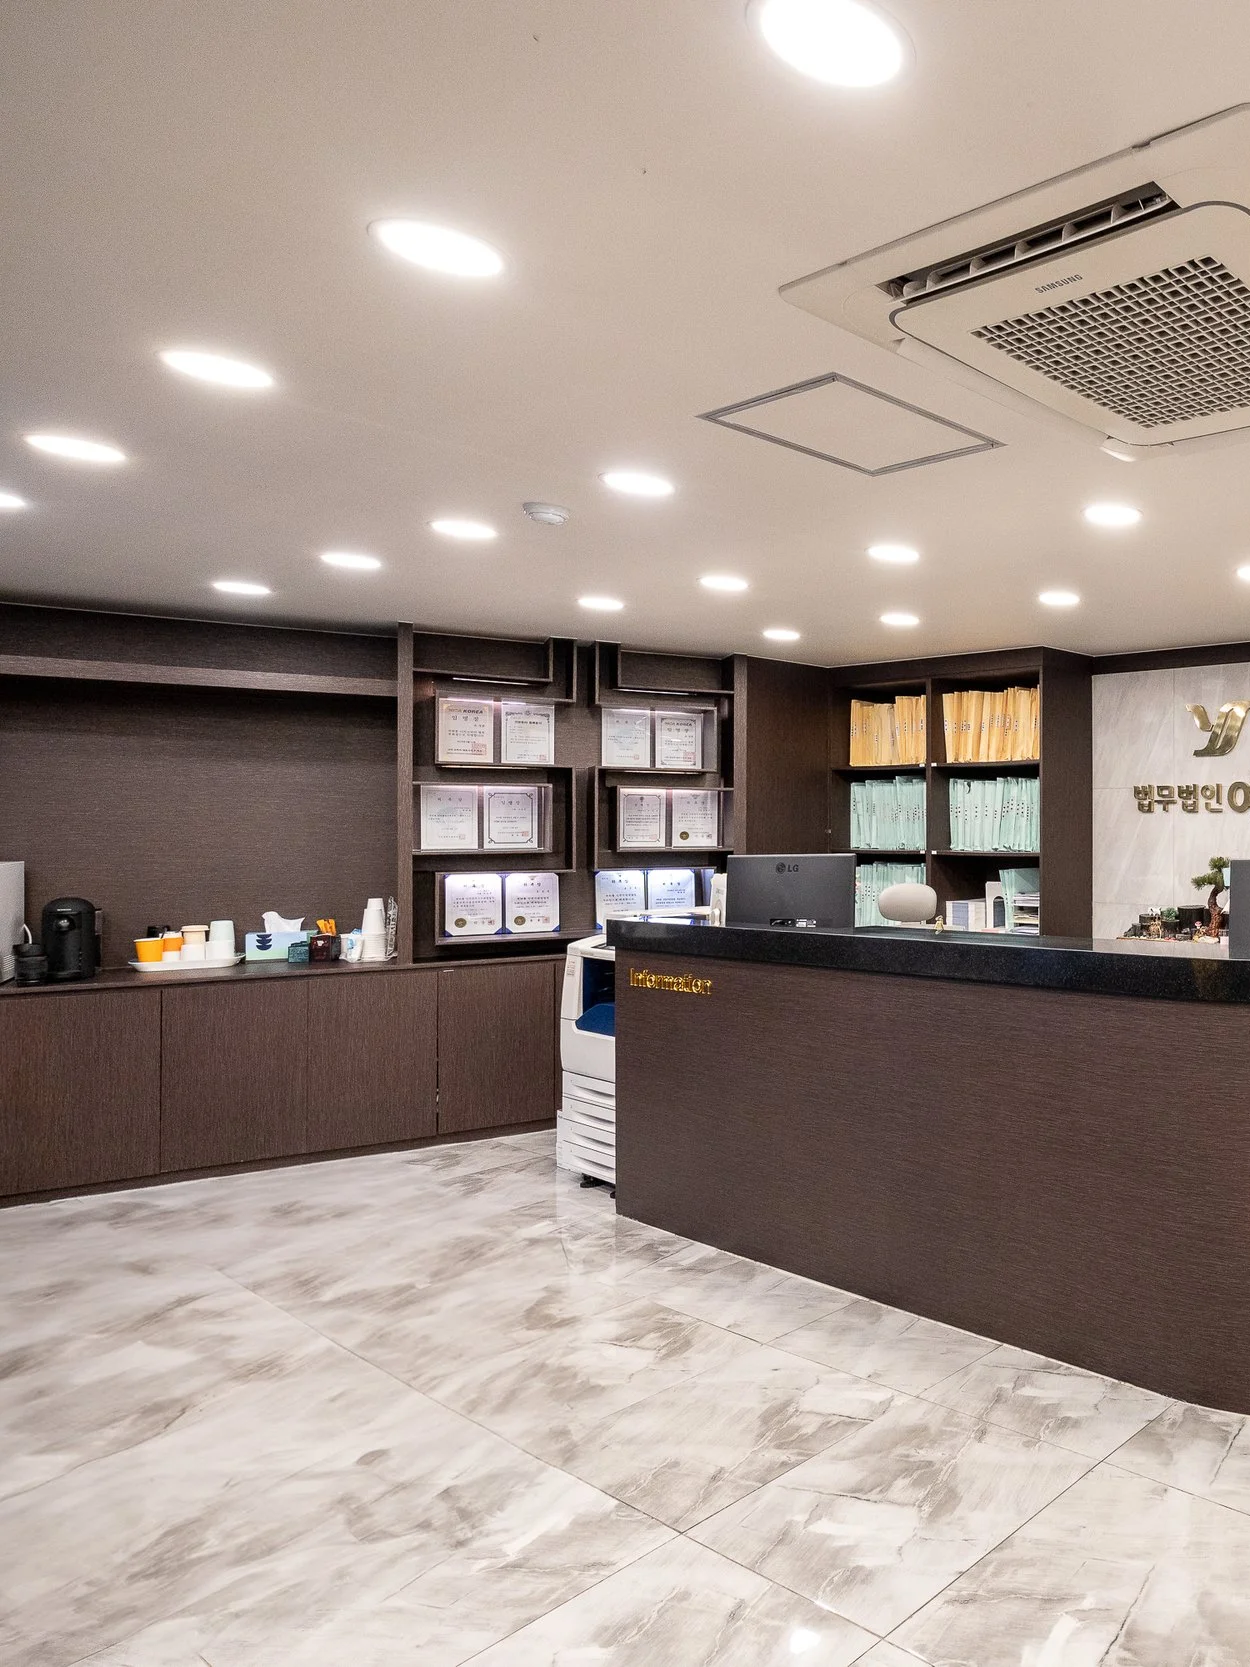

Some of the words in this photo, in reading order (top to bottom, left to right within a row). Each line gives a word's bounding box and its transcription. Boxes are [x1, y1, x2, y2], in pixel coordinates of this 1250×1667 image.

[1035, 274, 1083, 294] SAMSUNG
[787, 864, 799, 872] LG
[629, 967, 713, 995] Information
